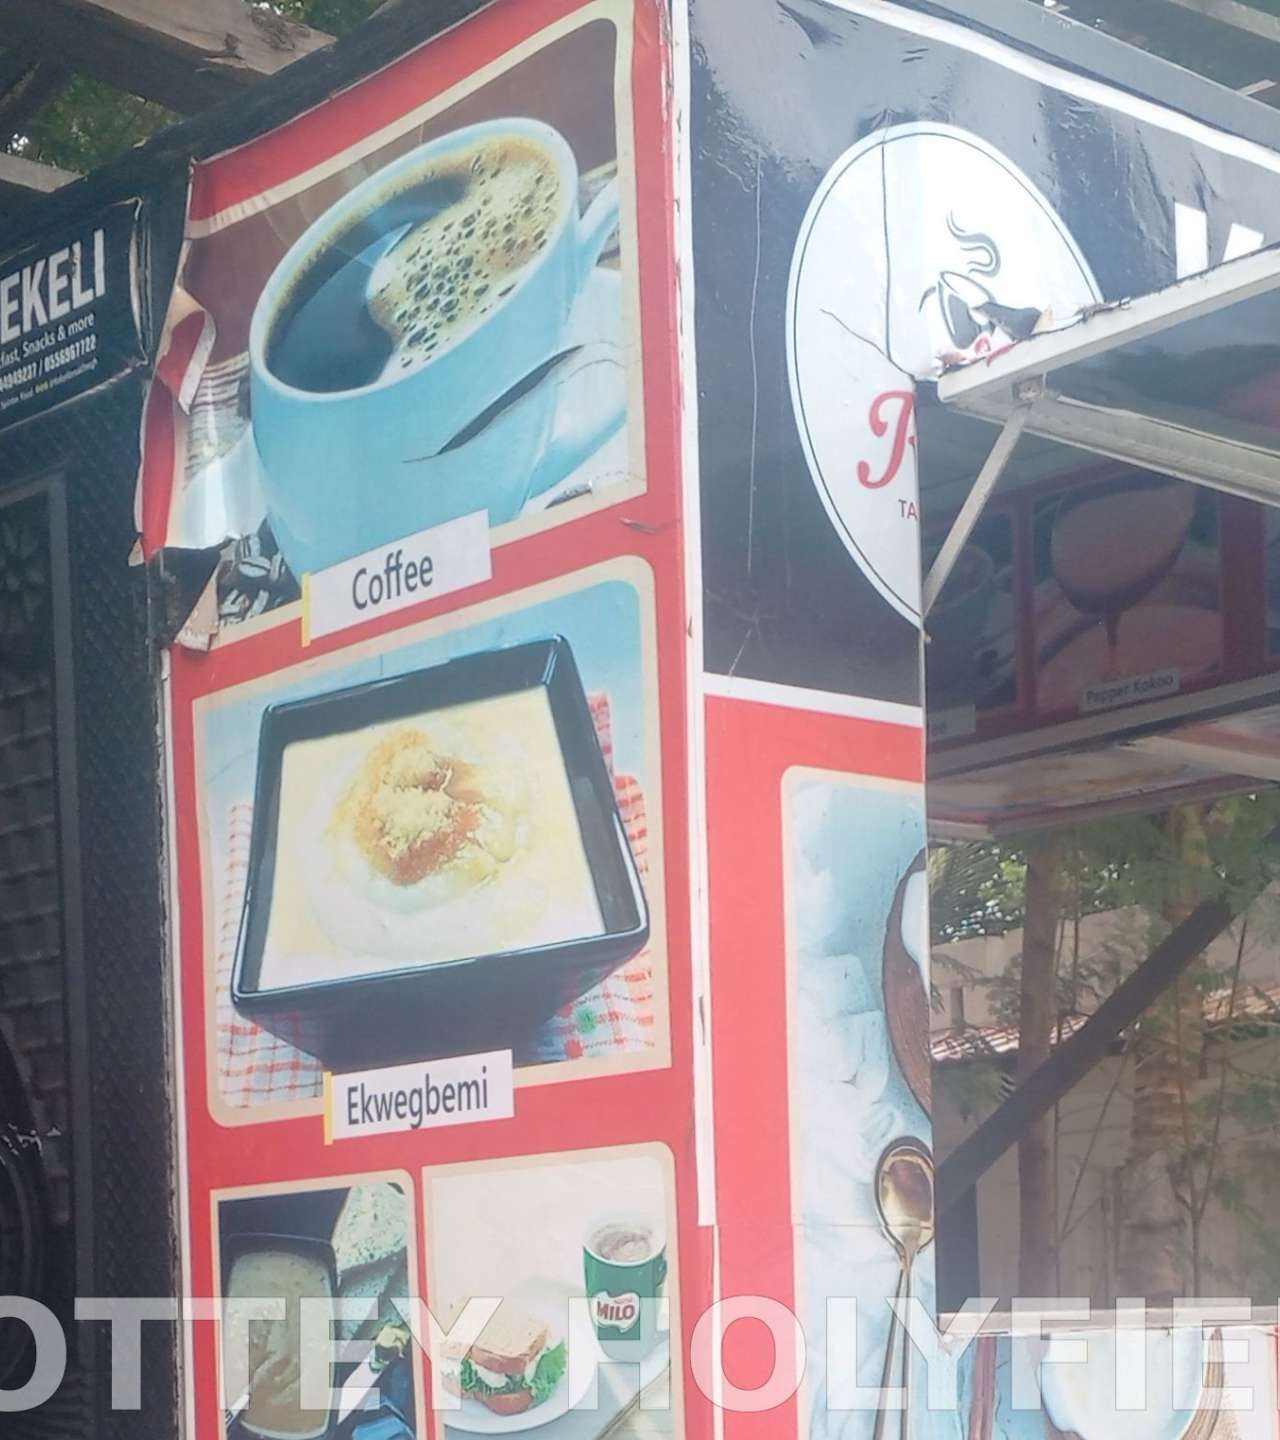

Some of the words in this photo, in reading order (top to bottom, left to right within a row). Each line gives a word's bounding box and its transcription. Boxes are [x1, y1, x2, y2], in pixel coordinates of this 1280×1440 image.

[68, 312, 96, 336] more
[352, 549, 434, 612] Coffee
[346, 1066, 490, 1129] Ekwegbemi
